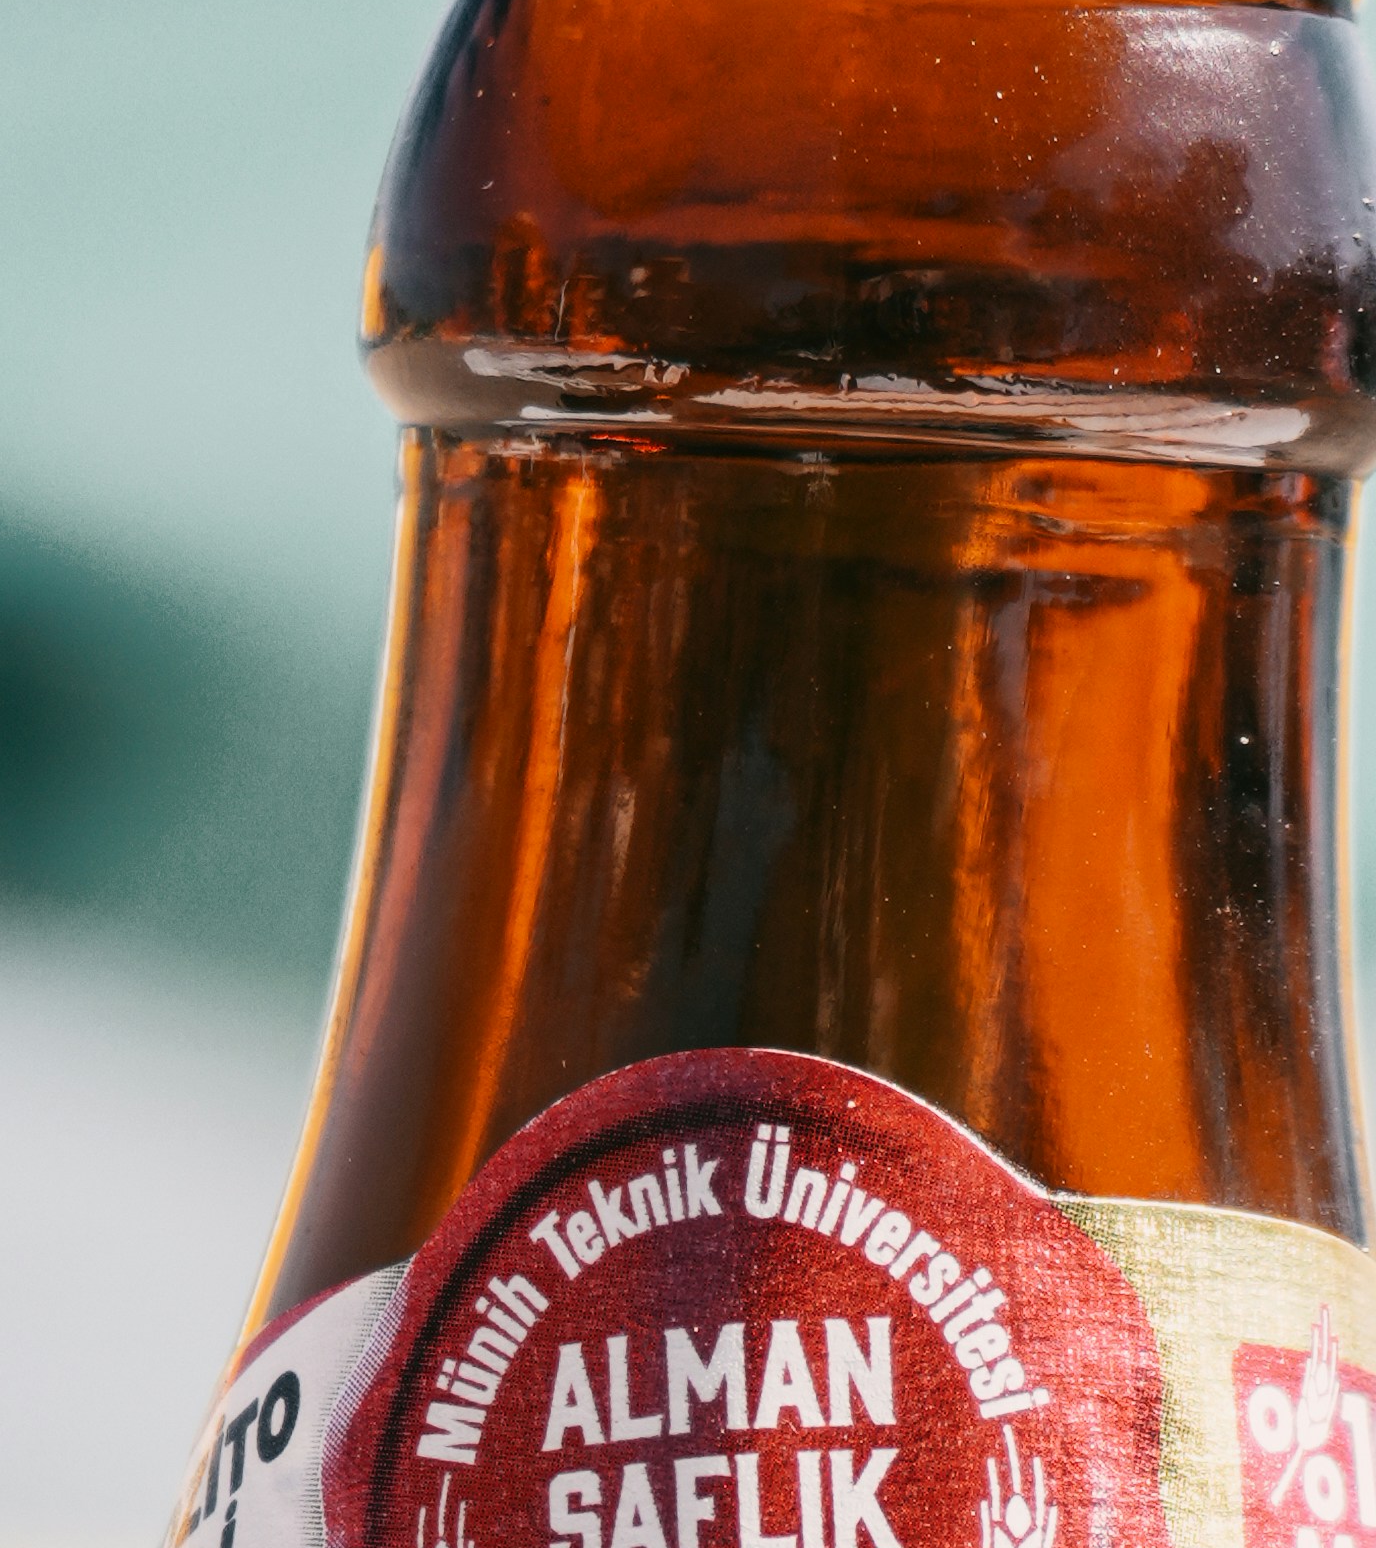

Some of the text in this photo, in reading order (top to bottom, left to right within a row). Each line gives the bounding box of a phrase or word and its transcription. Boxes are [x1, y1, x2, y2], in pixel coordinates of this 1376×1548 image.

[417, 1126, 1049, 1464] Münih Teknik Üniversitesi
[541, 1317, 895, 1450] ALMAN
